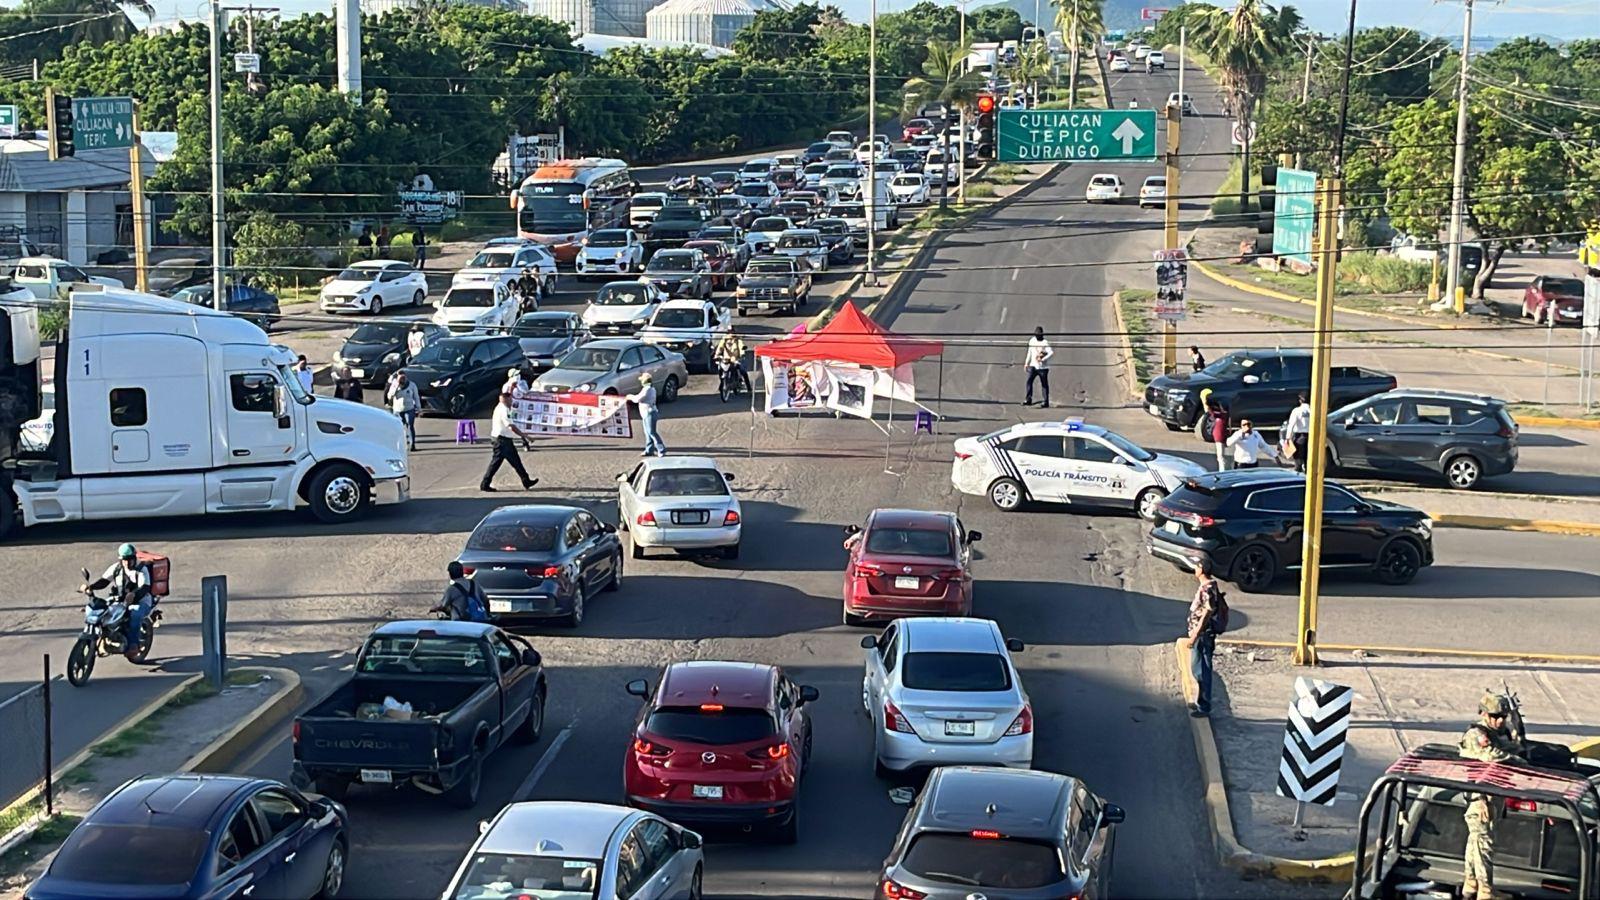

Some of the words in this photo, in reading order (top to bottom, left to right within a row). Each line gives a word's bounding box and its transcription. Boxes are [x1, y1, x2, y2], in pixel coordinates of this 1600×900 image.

[76, 117, 113, 132] CULIACAN
[1019, 114, 1102, 128] CULIACAN
[83, 132, 107, 147] TEPIC
[1029, 130, 1094, 143] TEPIC
[1019, 144, 1100, 159] DURANGO
[1025, 468, 1061, 479] POLICÍA
[1063, 471, 1108, 483] TRÁNSITO
